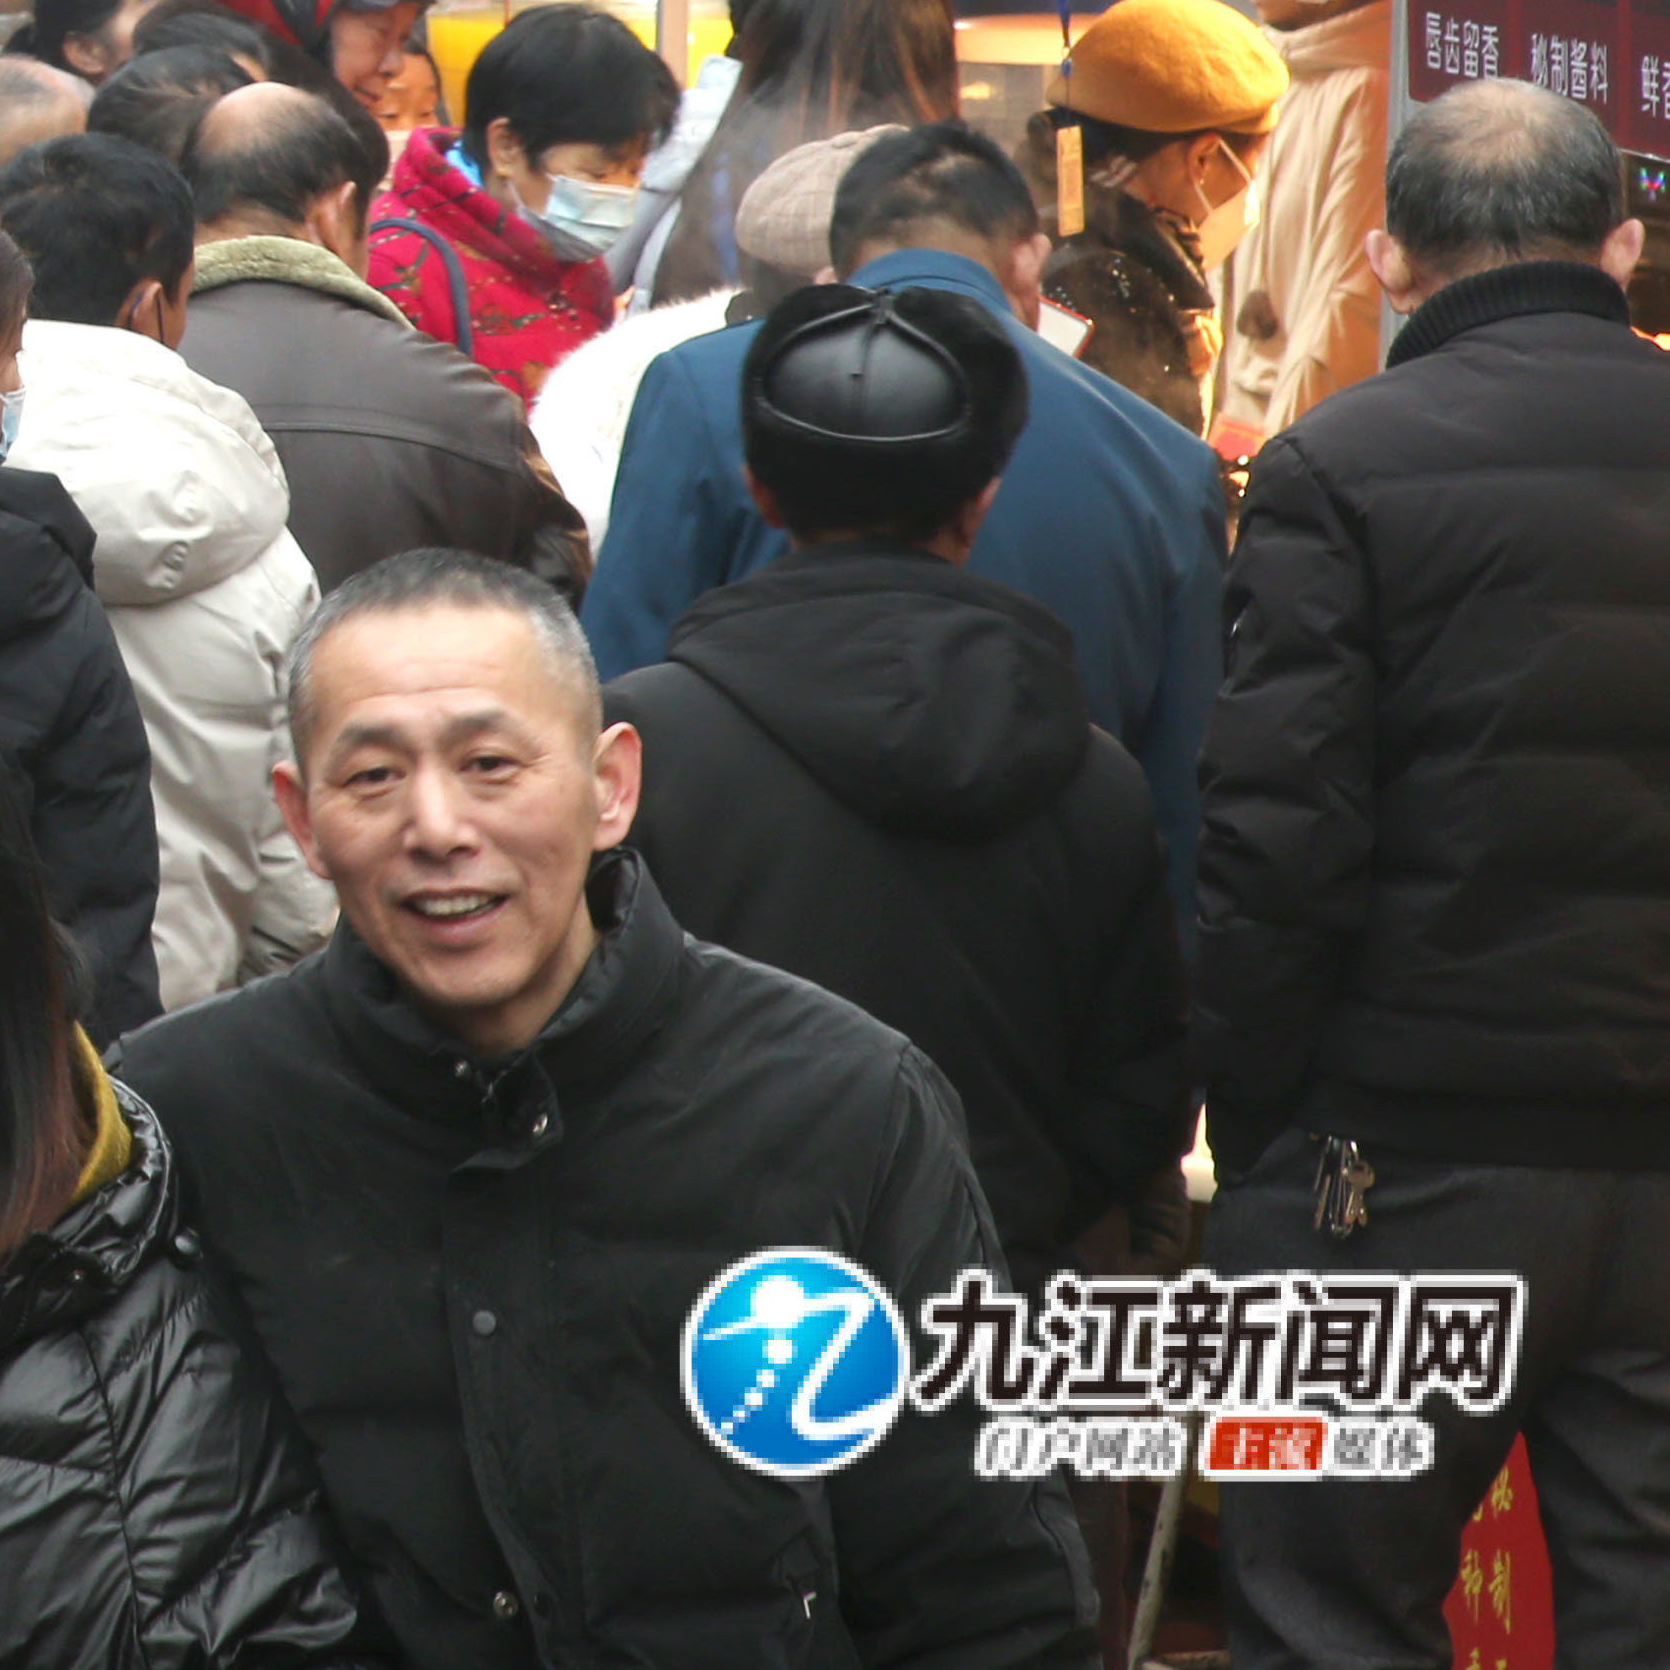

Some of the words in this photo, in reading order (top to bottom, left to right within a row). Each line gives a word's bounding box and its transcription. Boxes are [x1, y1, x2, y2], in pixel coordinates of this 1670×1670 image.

[1425, 11, 1499, 80] 唇齿留香
[1530, 32, 1608, 105] 秘制酱料
